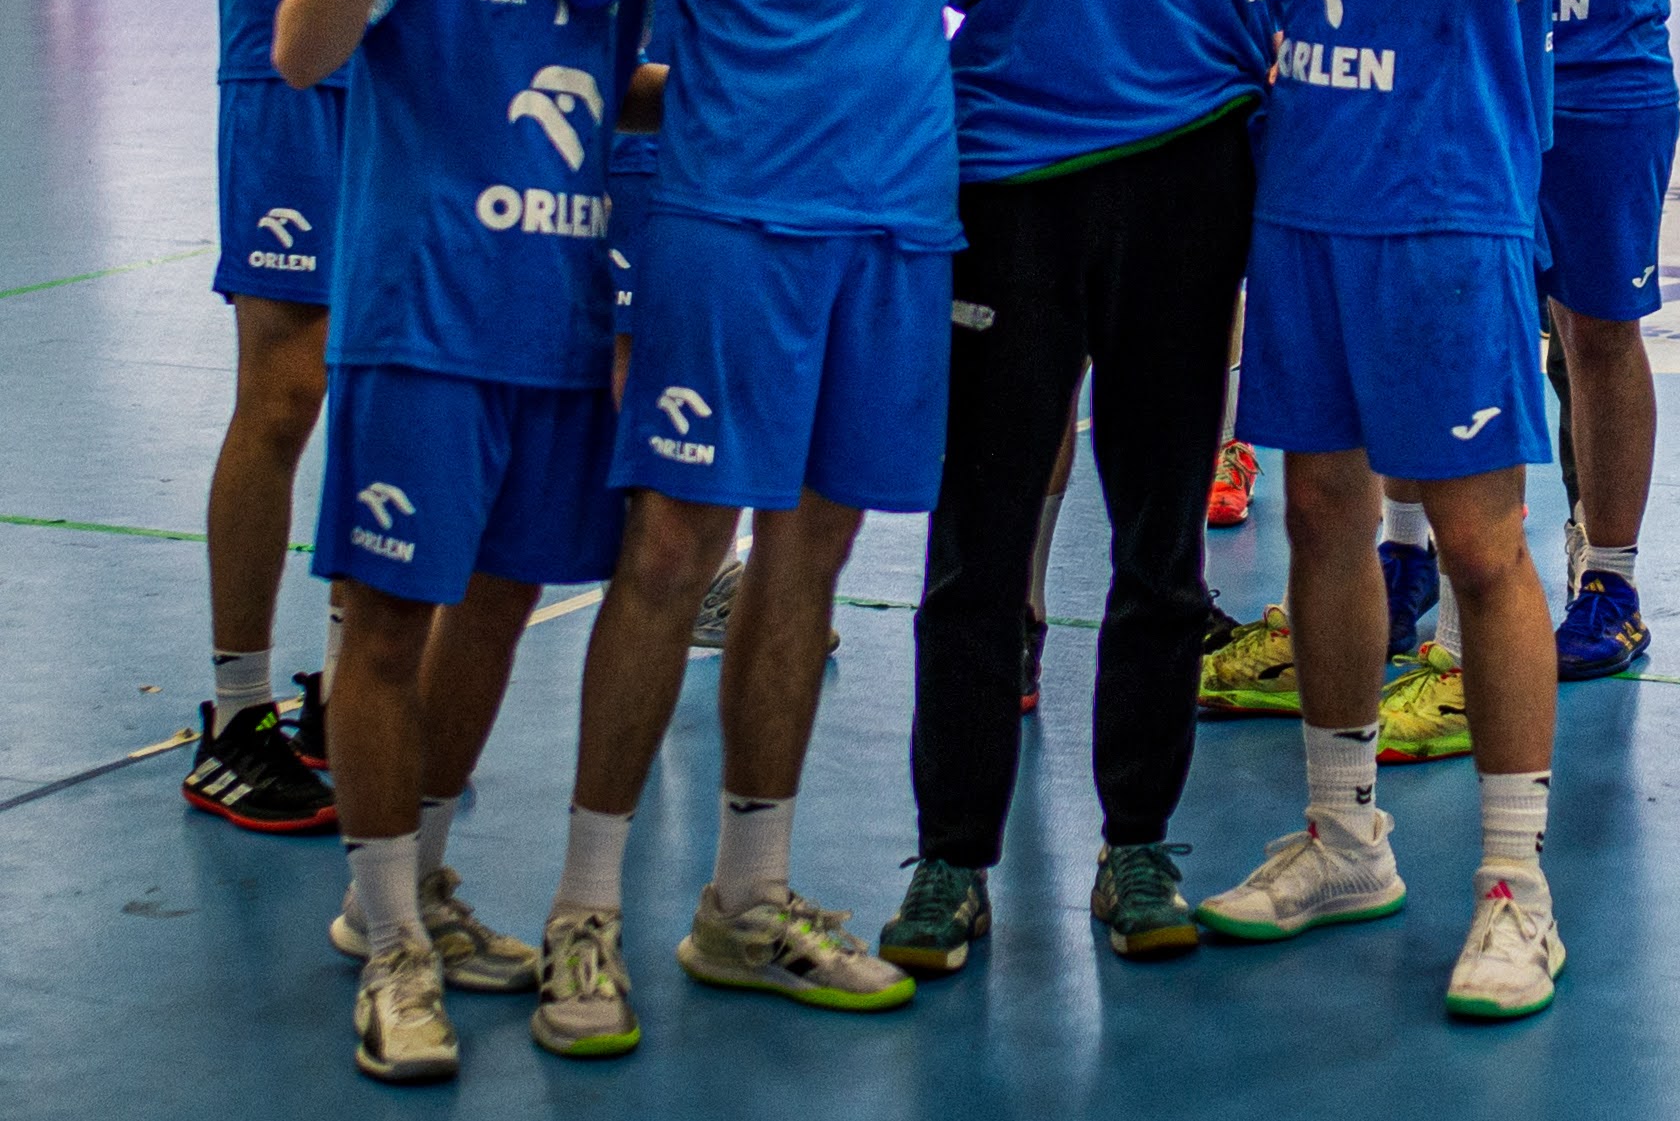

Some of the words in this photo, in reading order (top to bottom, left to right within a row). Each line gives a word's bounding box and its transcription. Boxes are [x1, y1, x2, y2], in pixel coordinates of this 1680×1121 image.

[1278, 40, 1395, 92] ORLEN
[476, 186, 608, 237] ORLEN
[248, 250, 317, 272] ORLEN
